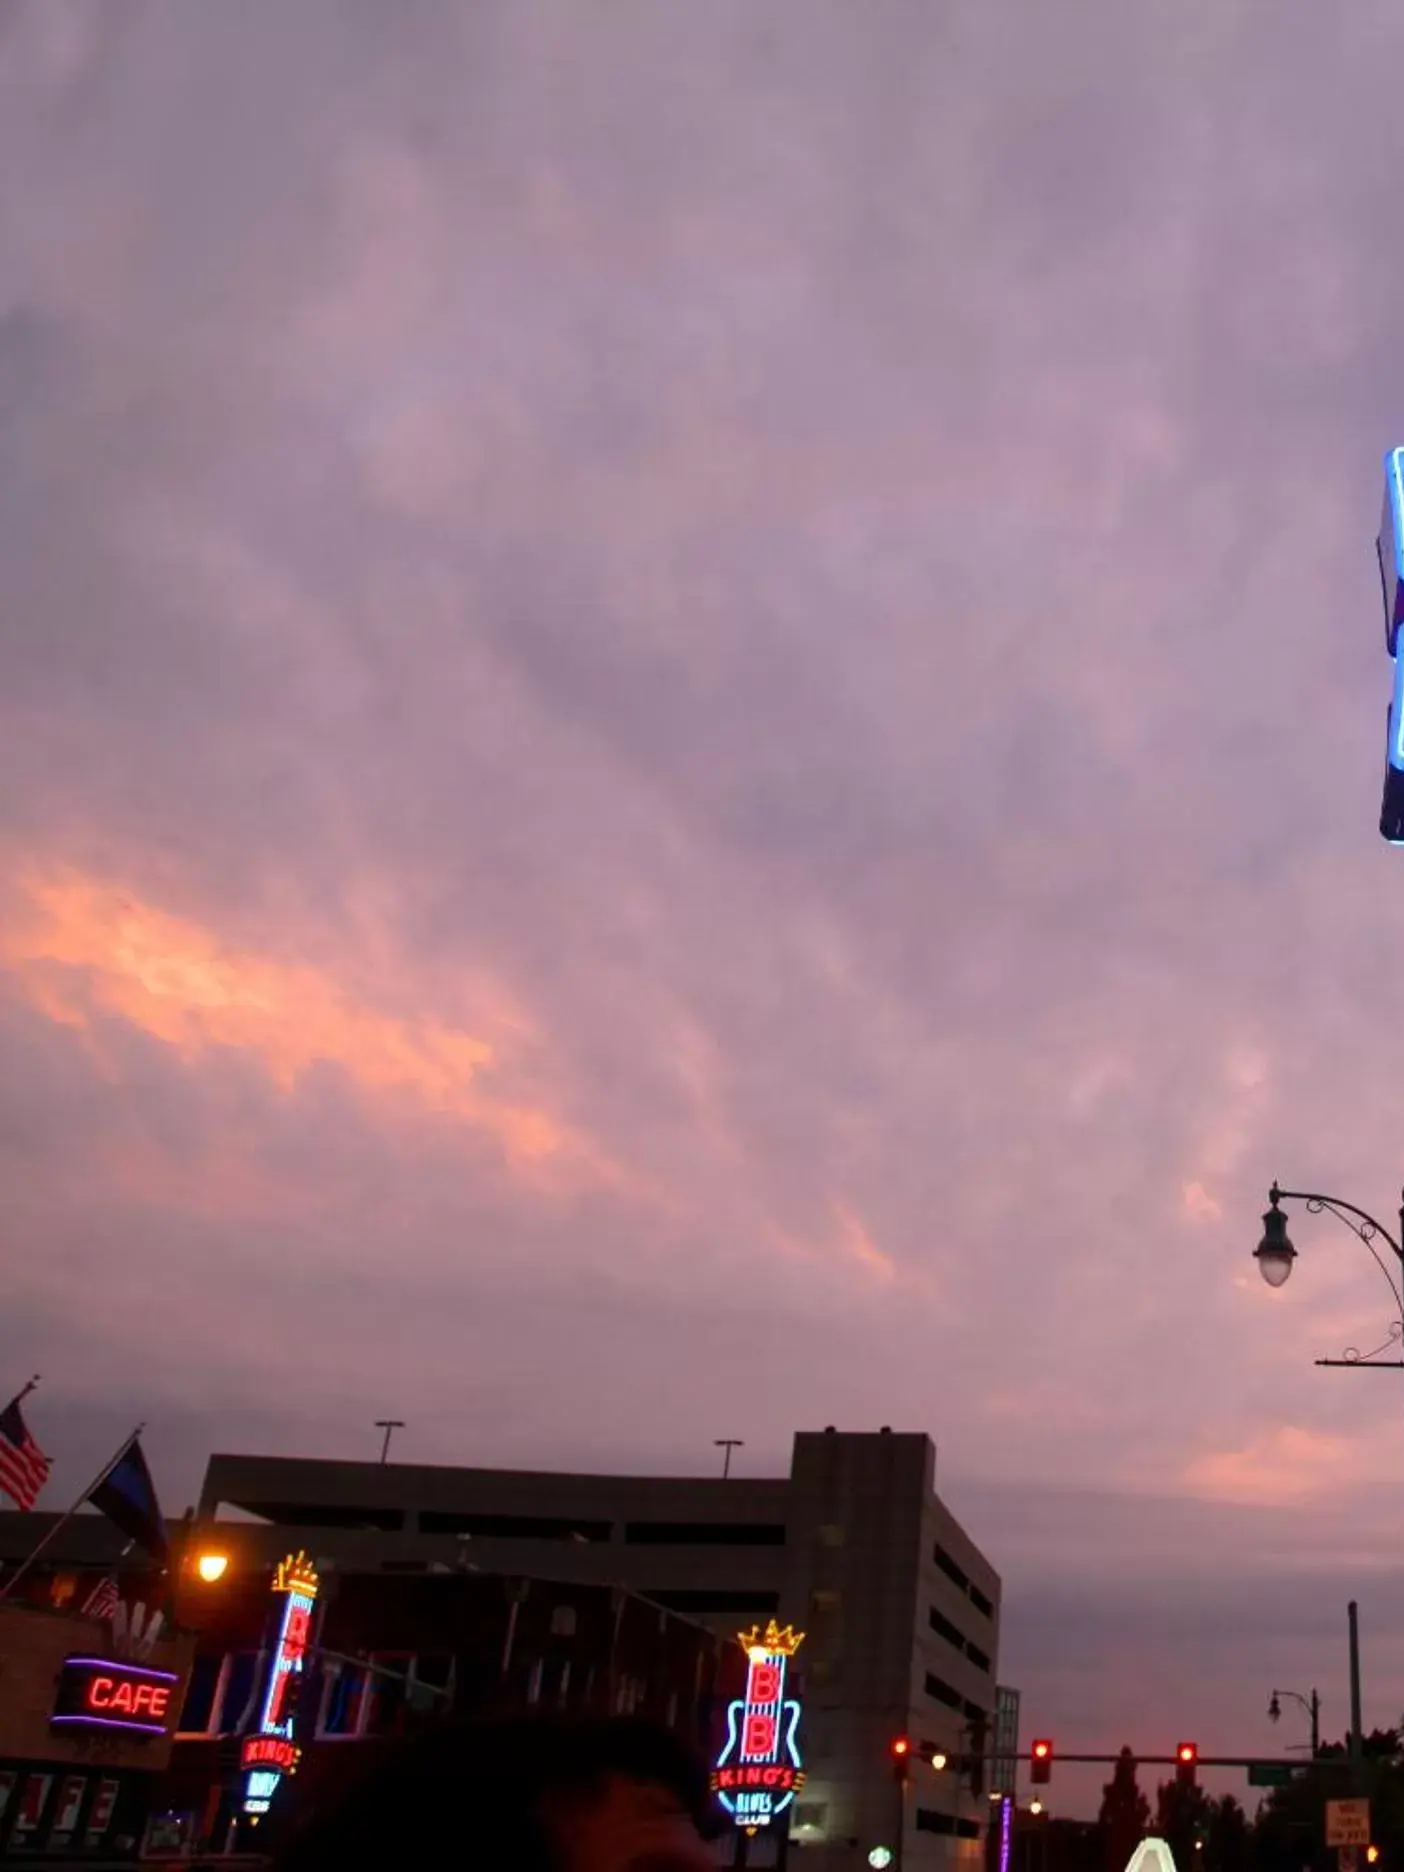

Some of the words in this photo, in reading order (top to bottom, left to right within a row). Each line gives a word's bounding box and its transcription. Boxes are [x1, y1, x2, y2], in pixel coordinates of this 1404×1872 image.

[90, 1677, 170, 1717] CAFE
[719, 1767, 793, 1788] KING'S
[735, 1815, 770, 1826] CLUB
